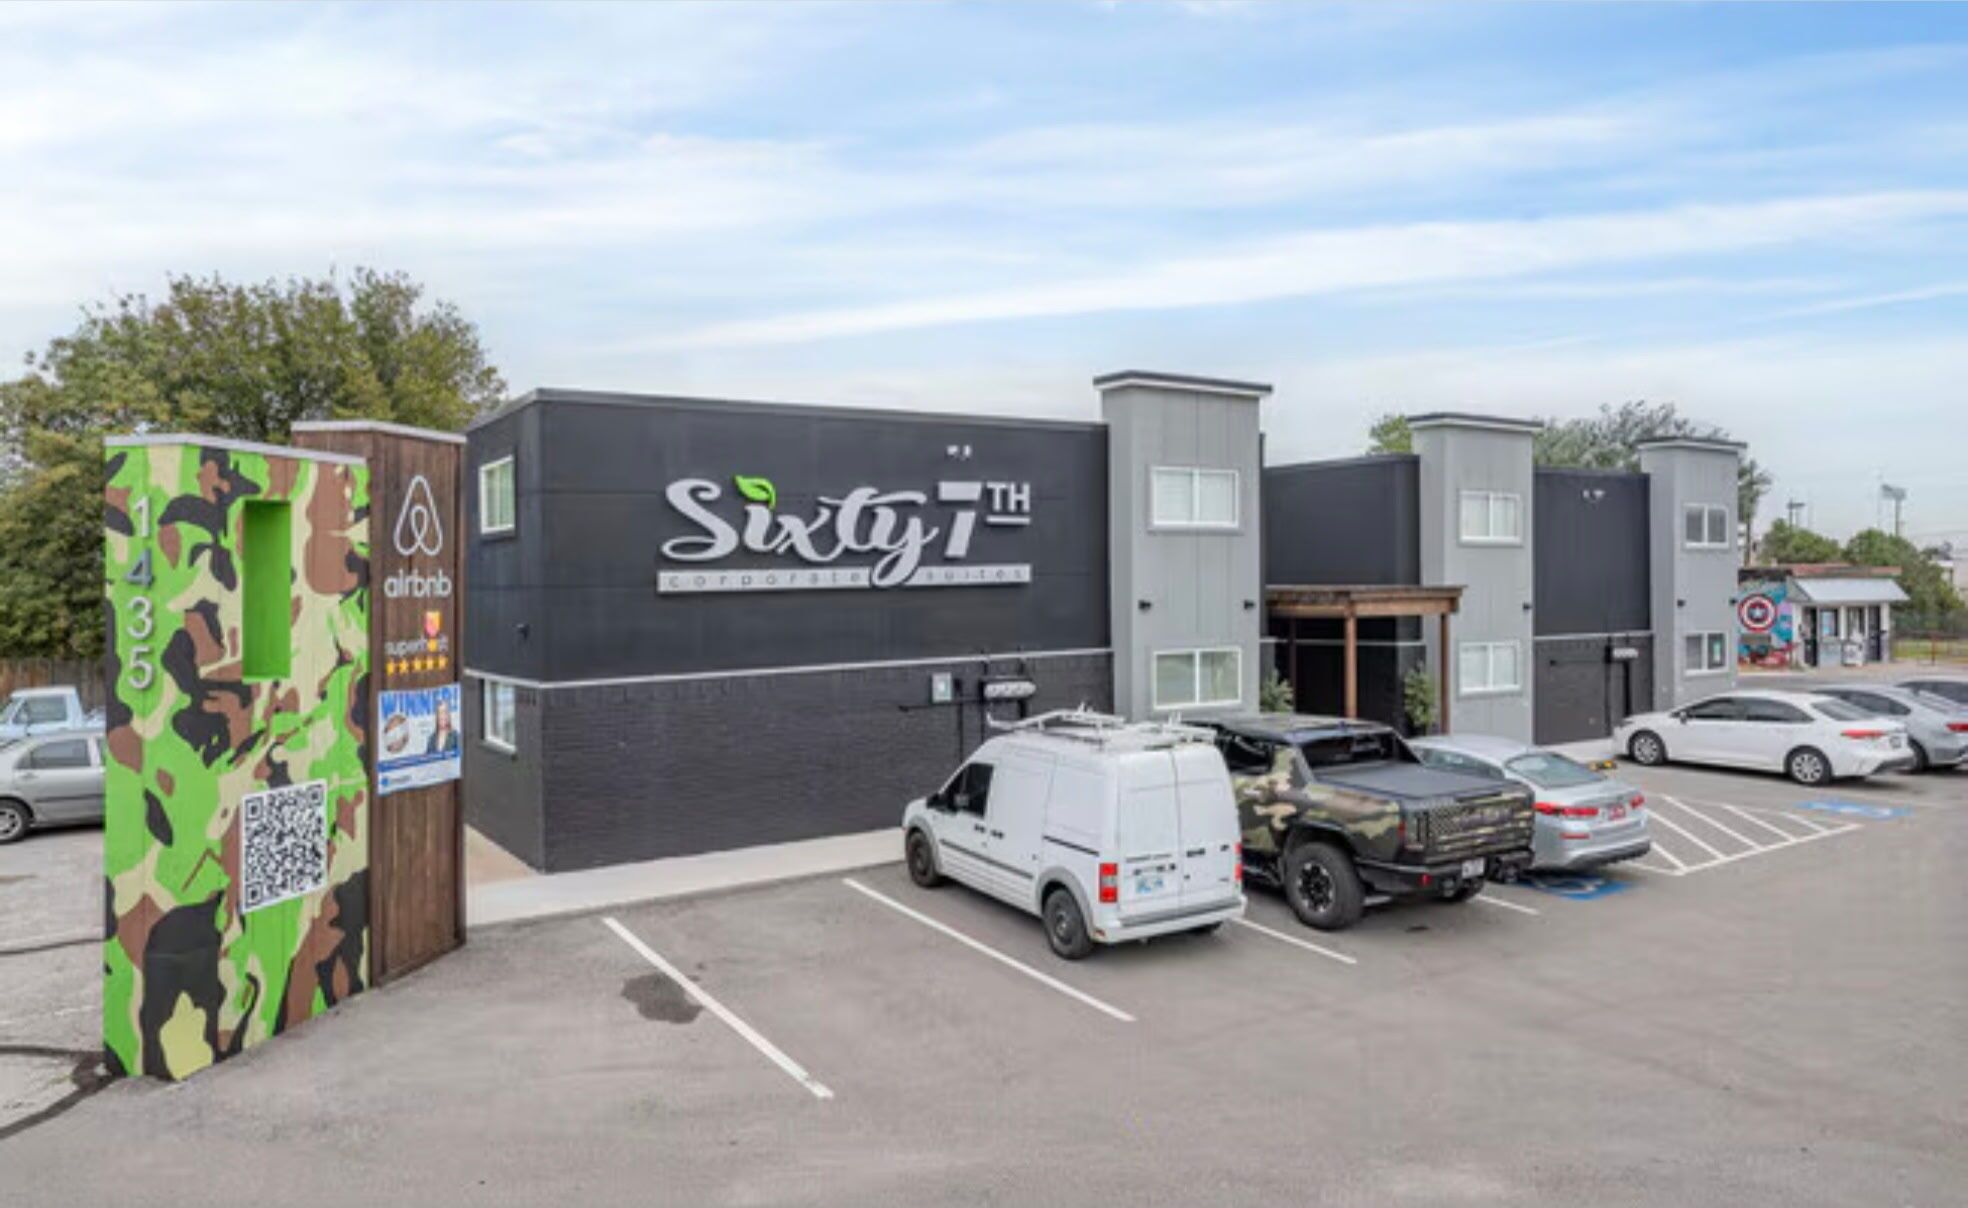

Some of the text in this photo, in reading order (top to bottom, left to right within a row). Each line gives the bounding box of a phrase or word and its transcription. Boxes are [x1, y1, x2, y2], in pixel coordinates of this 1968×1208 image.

[661, 475, 1032, 588] Sixty 7TH
[126, 496, 154, 689] 1435
[384, 568, 452, 598] airbnb
[668, 567, 1023, 588] corporate suites
